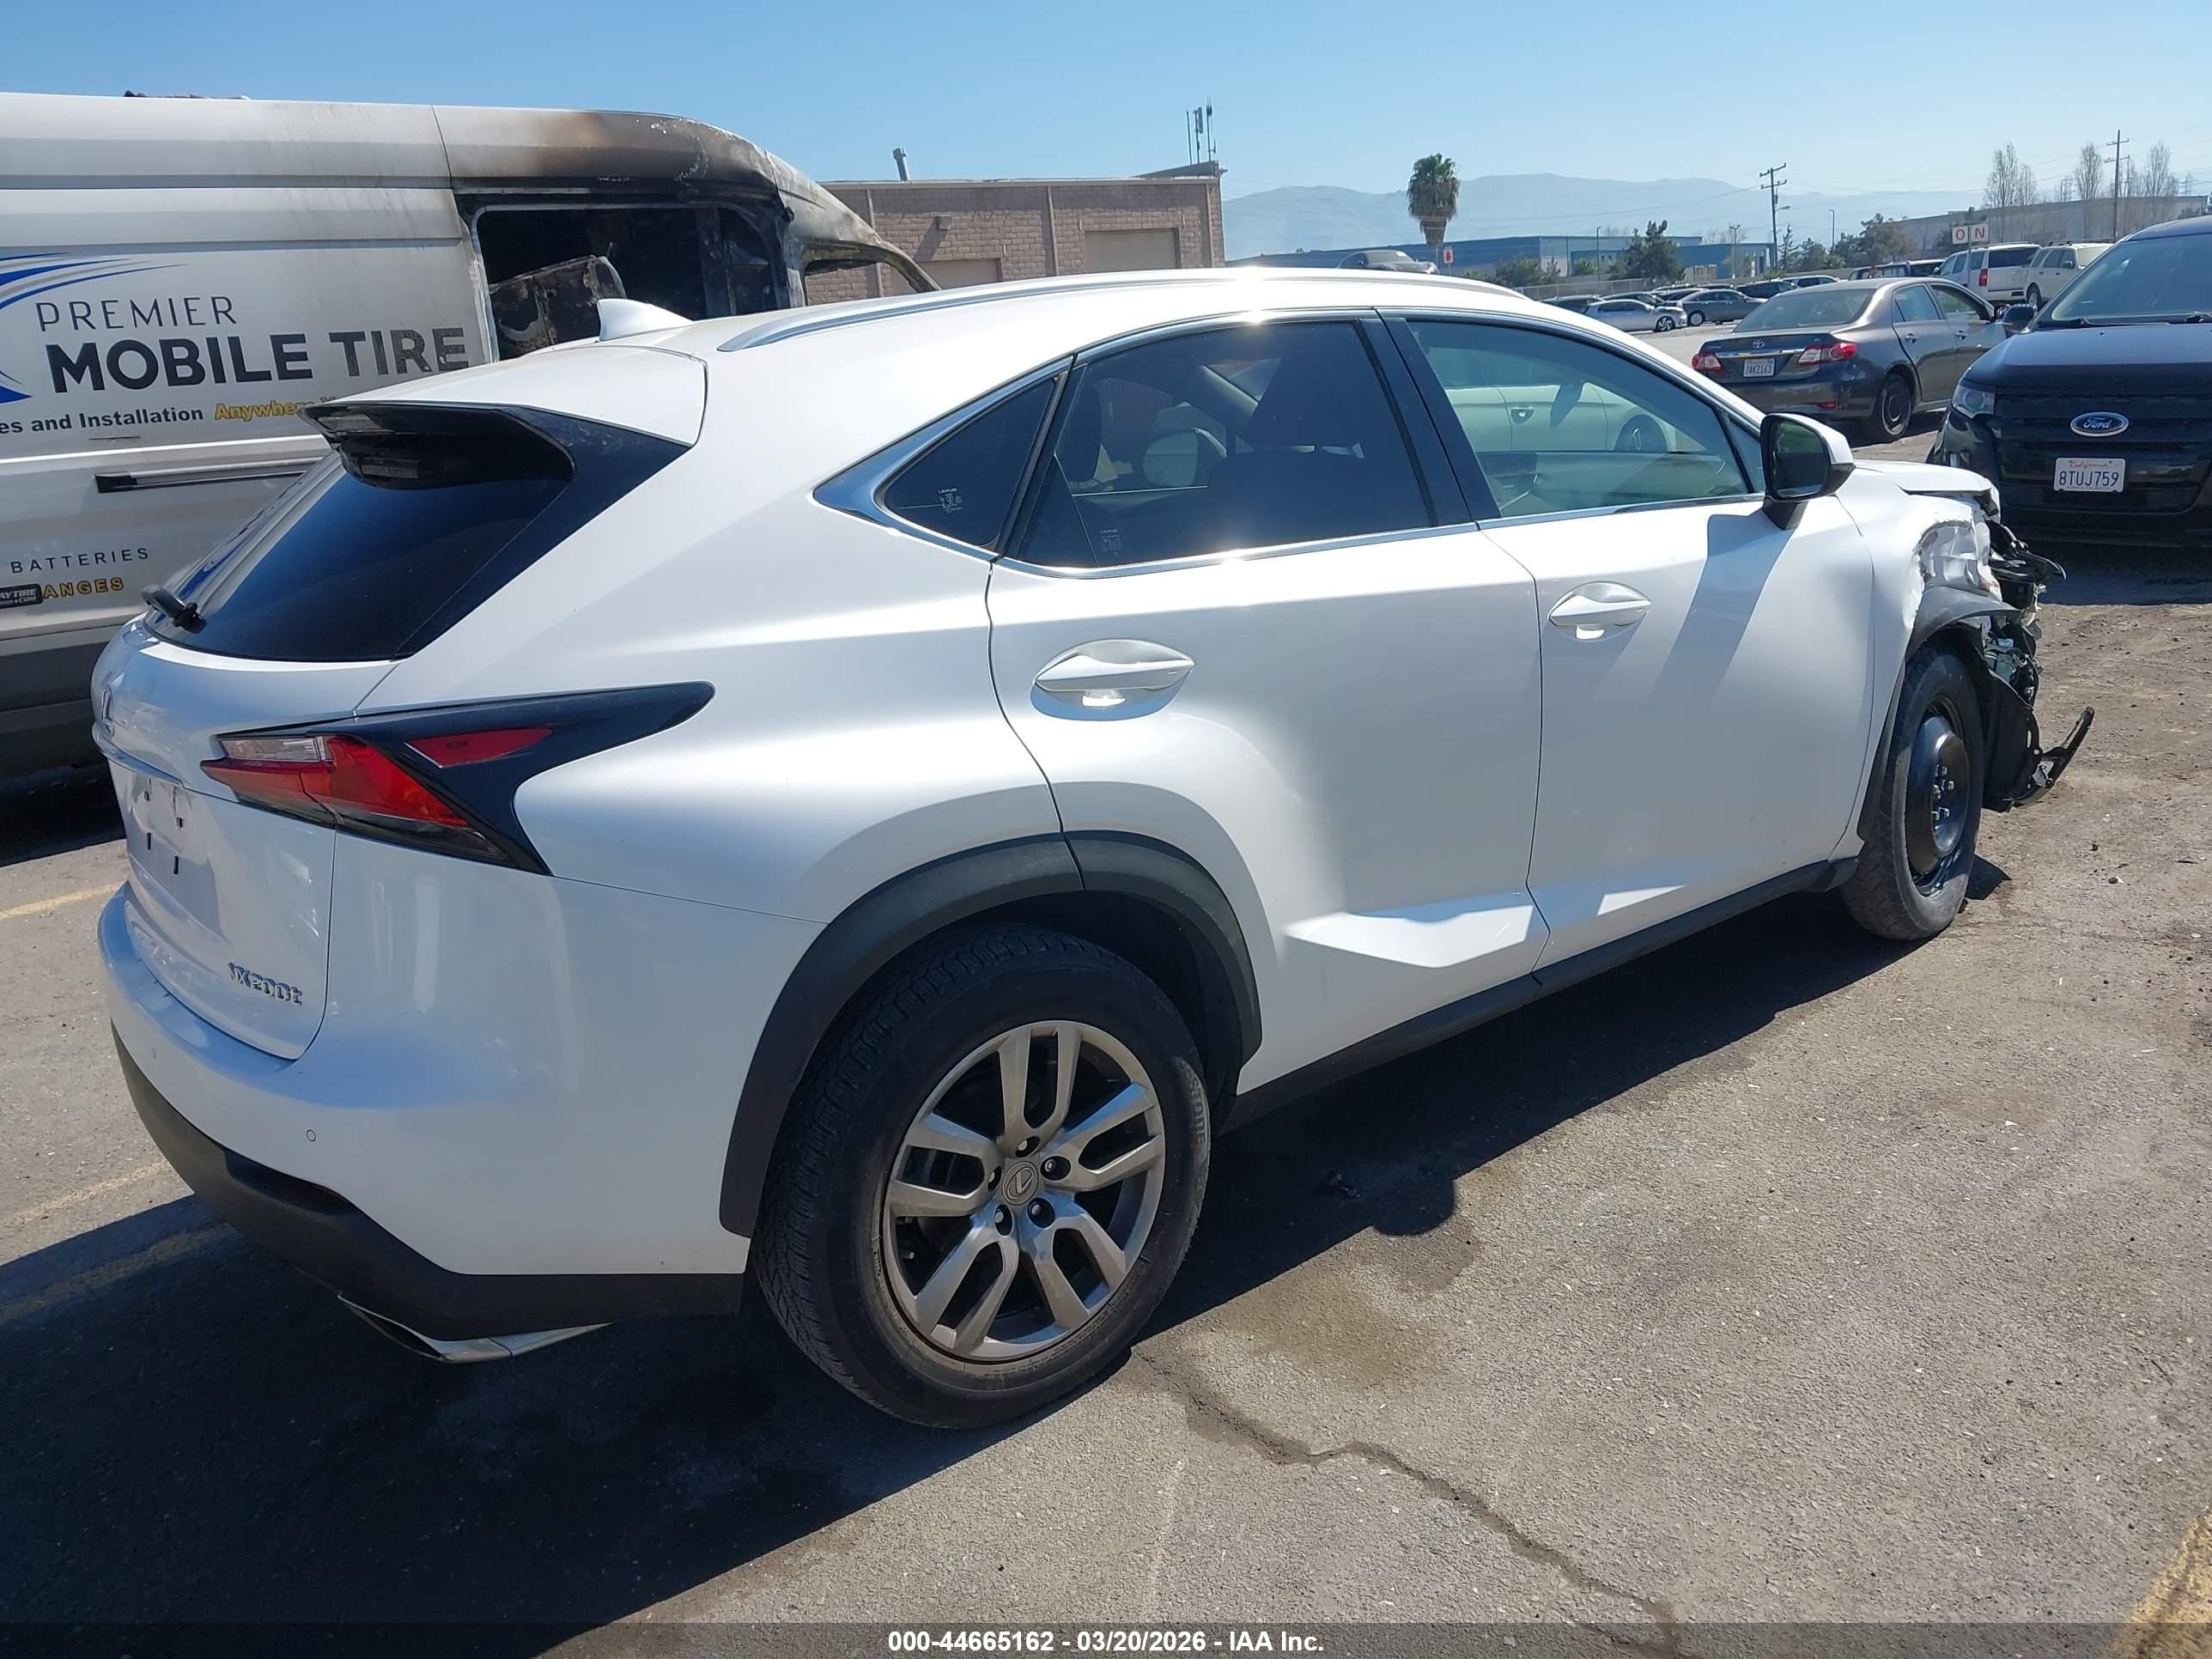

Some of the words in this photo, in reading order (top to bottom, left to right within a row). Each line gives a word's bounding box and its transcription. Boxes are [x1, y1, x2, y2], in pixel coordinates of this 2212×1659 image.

[35, 296, 238, 332] PREMIER
[46, 333, 313, 393] MOBILE
[329, 327, 469, 377] TIRE
[31, 414, 72, 432] and
[79, 407, 204, 428] Installation
[215, 398, 315, 422] Anywher
[2083, 417, 2112, 428] Ford
[2058, 471, 2119, 487] 8TUJ759
[10, 548, 149, 574] BATTERIES
[44, 577, 125, 599] ANGES
